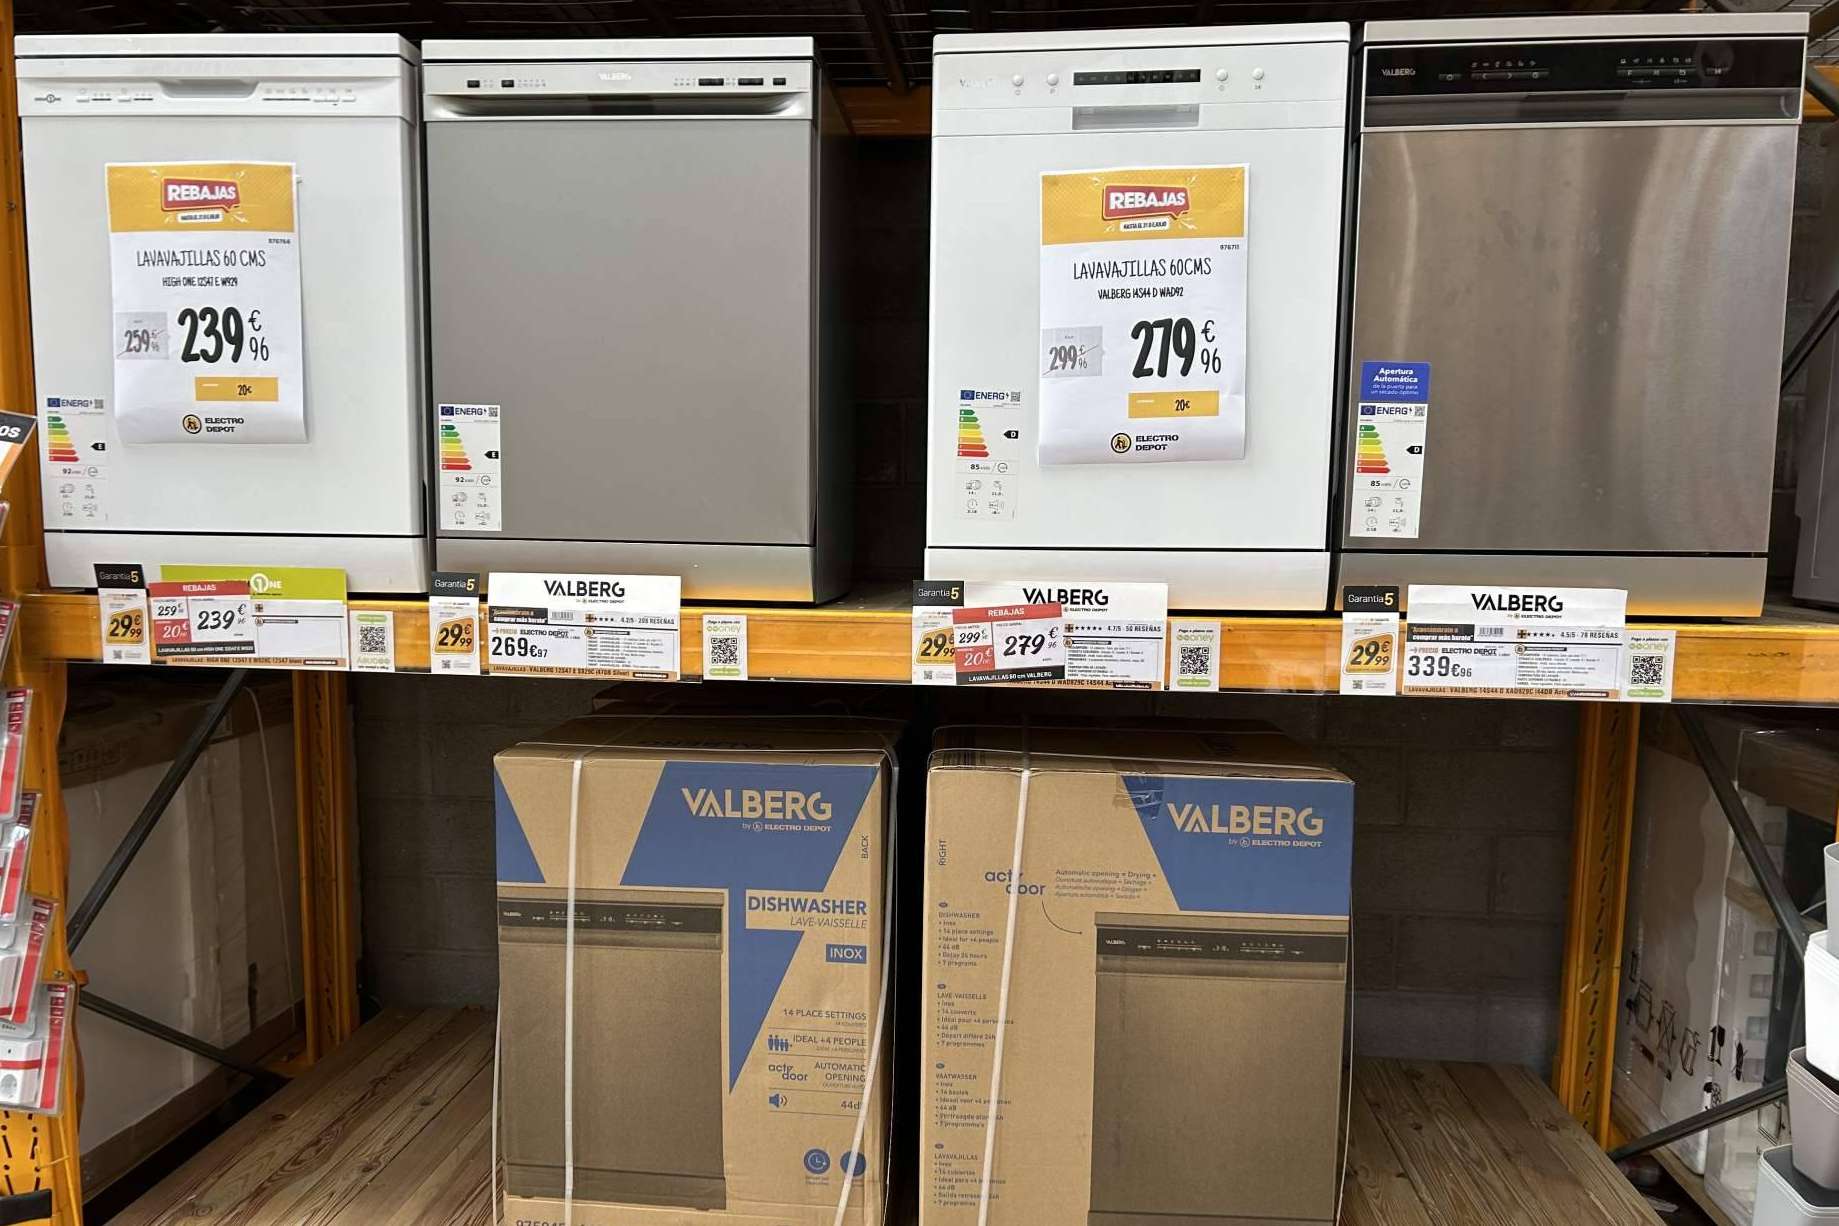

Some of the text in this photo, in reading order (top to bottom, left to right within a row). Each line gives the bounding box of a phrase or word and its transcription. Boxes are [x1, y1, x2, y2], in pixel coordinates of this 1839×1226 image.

[167, 184, 236, 202] REBAJAS
[1109, 192, 1186, 210] REBAJAS
[136, 250, 266, 266] LAVAVAJILLAS 60 CMS
[1074, 258, 1212, 280] LAVAVAJILLAS 60CMS
[162, 276, 181, 287] HIGH
[182, 276, 196, 287] ONE
[214, 276, 220, 286] E
[1098, 288, 1131, 300] VALBERG
[1152, 288, 1158, 298] D
[1160, 286, 1184, 298] WAD92
[124, 330, 150, 353] 259
[178, 306, 270, 364] 239 € 96
[1130, 318, 1222, 378] 279 € 96
[1049, 346, 1078, 370] 299
[1078, 358, 1088, 369] 96
[1374, 374, 1418, 382] Automática
[1379, 368, 1414, 376] Apertura
[976, 392, 1005, 400] ENERG
[61, 400, 89, 408] ENERG
[1175, 399, 1190, 411] 20€
[1376, 406, 1408, 415] ENERG
[455, 408, 482, 416] ENERG
[1136, 434, 1179, 442] ELECTRO
[544, 580, 626, 598] VALBERG
[1022, 588, 1109, 606] VALBERG
[1471, 594, 1564, 612] VALBERG
[158, 606, 177, 616] 259
[197, 604, 246, 630] 239 €
[988, 608, 1024, 617] REBAJAS
[110, 614, 132, 636] 29
[130, 628, 142, 638] 99
[163, 625, 180, 638] 20
[438, 623, 463, 646] 29
[460, 638, 472, 647] 99
[958, 632, 981, 644] 299
[1003, 634, 1046, 656] 279
[1048, 626, 1058, 638] €
[920, 633, 946, 656] 29
[964, 652, 984, 666] 20
[1350, 640, 1390, 666] 29 € 99
[682, 788, 832, 820] VALBERG
[1167, 802, 1324, 837] VALBERG
[860, 835, 869, 860] BACK
[1228, 838, 1238, 846] by
[938, 839, 948, 866] RIGHT
[748, 896, 867, 915] DISHWASHER
[790, 916, 867, 930] LAVE-VAISSELLE
[830, 946, 863, 960] INOX
[796, 1010, 824, 1018] PLACE
[825, 1012, 866, 1020] SETTINGS
[793, 1034, 818, 1044] IDEAL
[833, 1038, 866, 1046] PEOPLE
[815, 1062, 866, 1072] AUTOMATIC
[825, 1072, 866, 1082] OPENING
[840, 1100, 862, 1110] 44d
